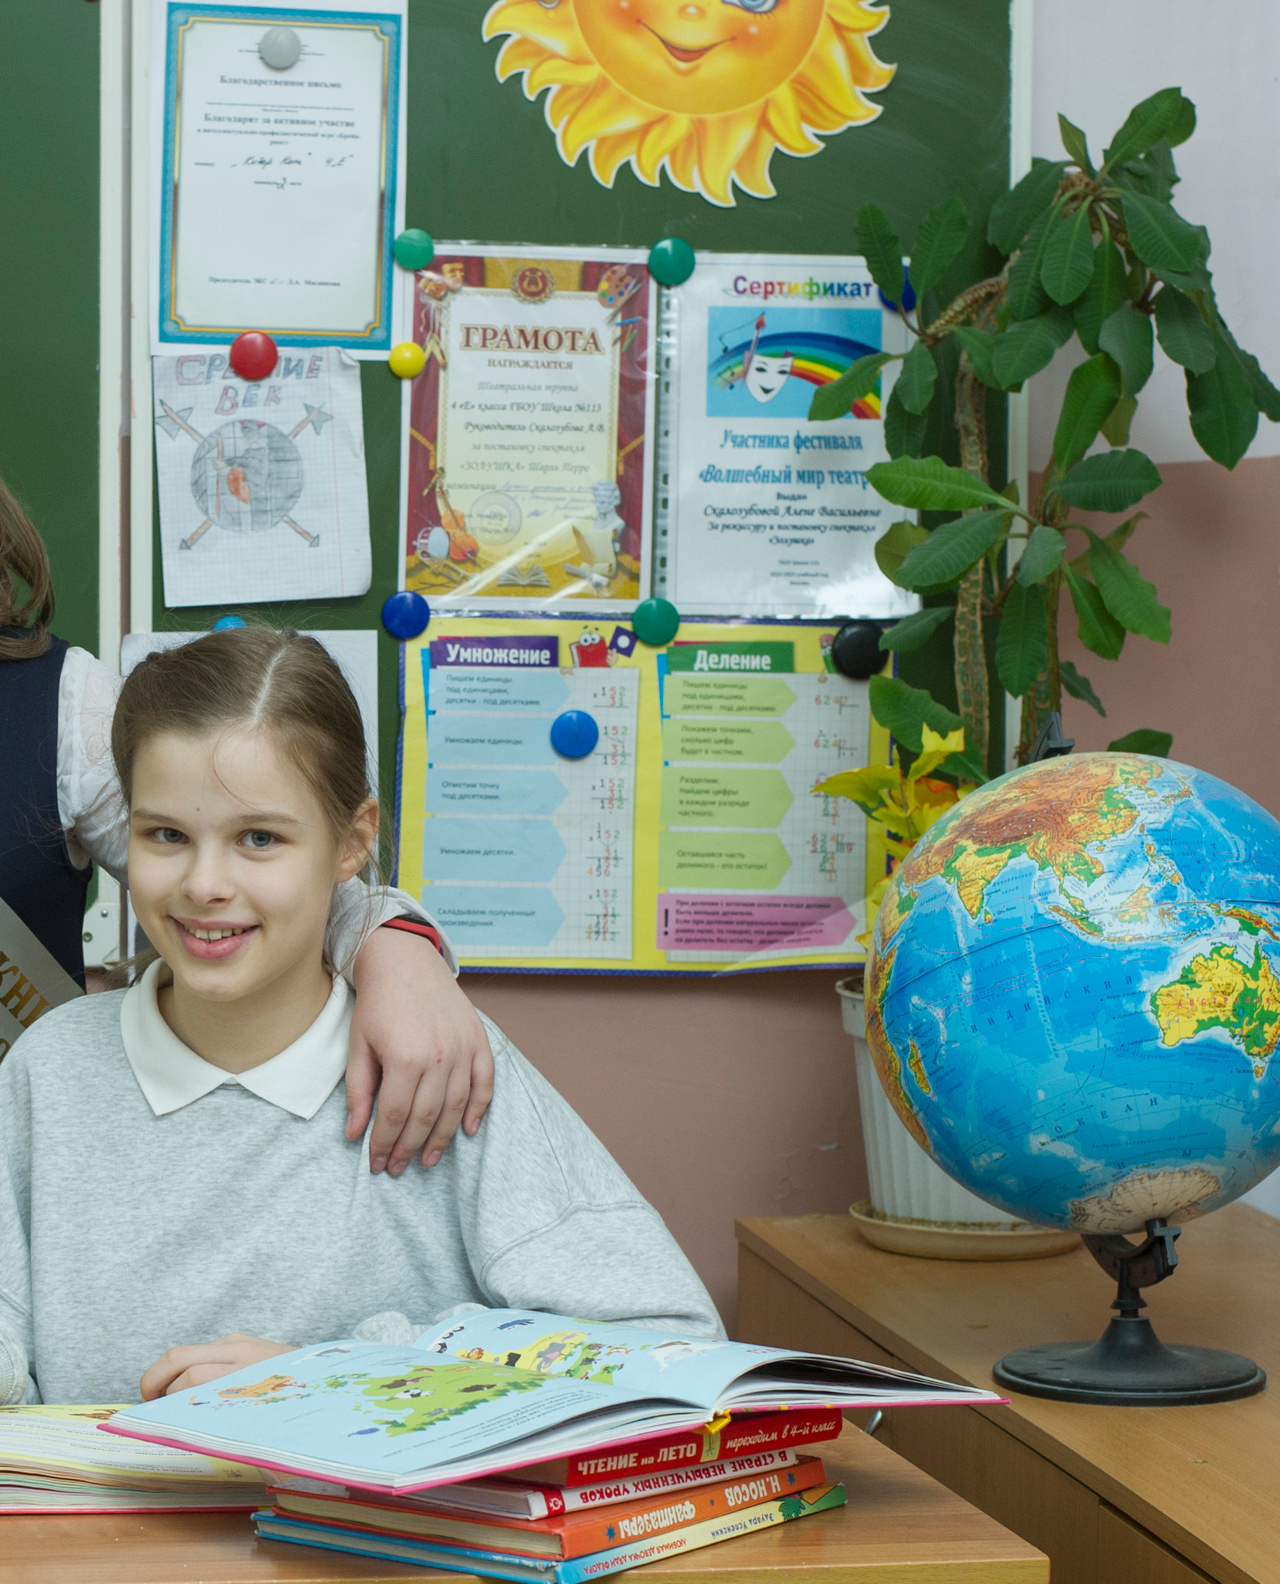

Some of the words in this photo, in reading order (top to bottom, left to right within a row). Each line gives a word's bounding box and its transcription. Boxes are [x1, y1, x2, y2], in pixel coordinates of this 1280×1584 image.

[219, 75, 304, 87] Благодарственное
[307, 80, 342, 88] письмо
[204, 113, 258, 125] Благодарит
[733, 275, 872, 301] Сертификат
[462, 325, 603, 353] ГРАМОТА
[487, 358, 573, 370] НАГРАЖДАЕТСЯ
[477, 381, 542, 393] Театральная
[544, 384, 578, 395] труппа
[478, 403, 507, 412] класса
[541, 402, 572, 414] Школа
[463, 421, 526, 434] Руководитель
[528, 421, 583, 434] Скалозубова
[720, 429, 789, 449] Участника
[793, 430, 863, 454] фестиваля
[484, 444, 535, 454] постановку
[537, 443, 585, 452] спектакля
[698, 464, 792, 484] «Волшебный
[796, 469, 824, 489] мир
[776, 491, 807, 501] Выдан
[704, 503, 779, 522] Скалозубовой
[776, 523, 827, 534] постановку
[829, 524, 876, 533] спектакля
[768, 536, 815, 546] «Золушка»
[446, 643, 551, 665] Умножение
[693, 649, 771, 671] Деление
[445, 674, 475, 683] Пишем
[476, 675, 513, 684] единицы
[445, 686, 460, 695] под
[682, 681, 711, 689] Пишем
[713, 681, 748, 690] единицы
[445, 697, 477, 706] десятки
[483, 698, 496, 706] под
[682, 692, 697, 700] под
[681, 703, 712, 712] десятки
[719, 704, 734, 712] под
[681, 725, 717, 733] Покажем
[444, 736, 485, 745] Умножаем
[681, 736, 711, 744] сколько
[713, 736, 734, 746] цифр
[442, 781, 477, 789] Отметим
[478, 782, 500, 790] точку
[441, 792, 456, 801] под
[712, 788, 739, 797] цифры
[685, 799, 716, 807] каждом
[439, 847, 481, 856] Умножаем
[677, 850, 723, 858] Оставшаяся
[676, 861, 715, 870] делимого
[437, 908, 486, 916] Складываем
[488, 908, 536, 917] полученные
[970, 974, 1133, 1034] ИНДИЙСКИЙ
[1177, 996, 1270, 1007] АВСТРАЛИЯ
[1054, 1097, 1158, 1133] ОКЕАН
[726, 1430, 778, 1450] переходим
[781, 1426, 788, 1440] в
[811, 1419, 836, 1433] класс
[577, 1452, 638, 1476] ЧТЕНИЕ
[640, 1455, 654, 1466] на
[657, 1442, 697, 1462] ЛЕТО
[778, 1450, 788, 1462] В
[731, 1453, 775, 1473] СТРАНЕ
[634, 1464, 726, 1492] НЕВЫУЧЕННЫХ
[579, 1483, 630, 1503] УРОКОВ
[748, 1512, 775, 1526] Эдуард
[710, 1520, 748, 1539] Успенский
[655, 1537, 687, 1554] ЛЮБИМАЯ
[627, 1546, 656, 1562] ДЕВОЧКА
[610, 1554, 627, 1567] ДЯДИ
